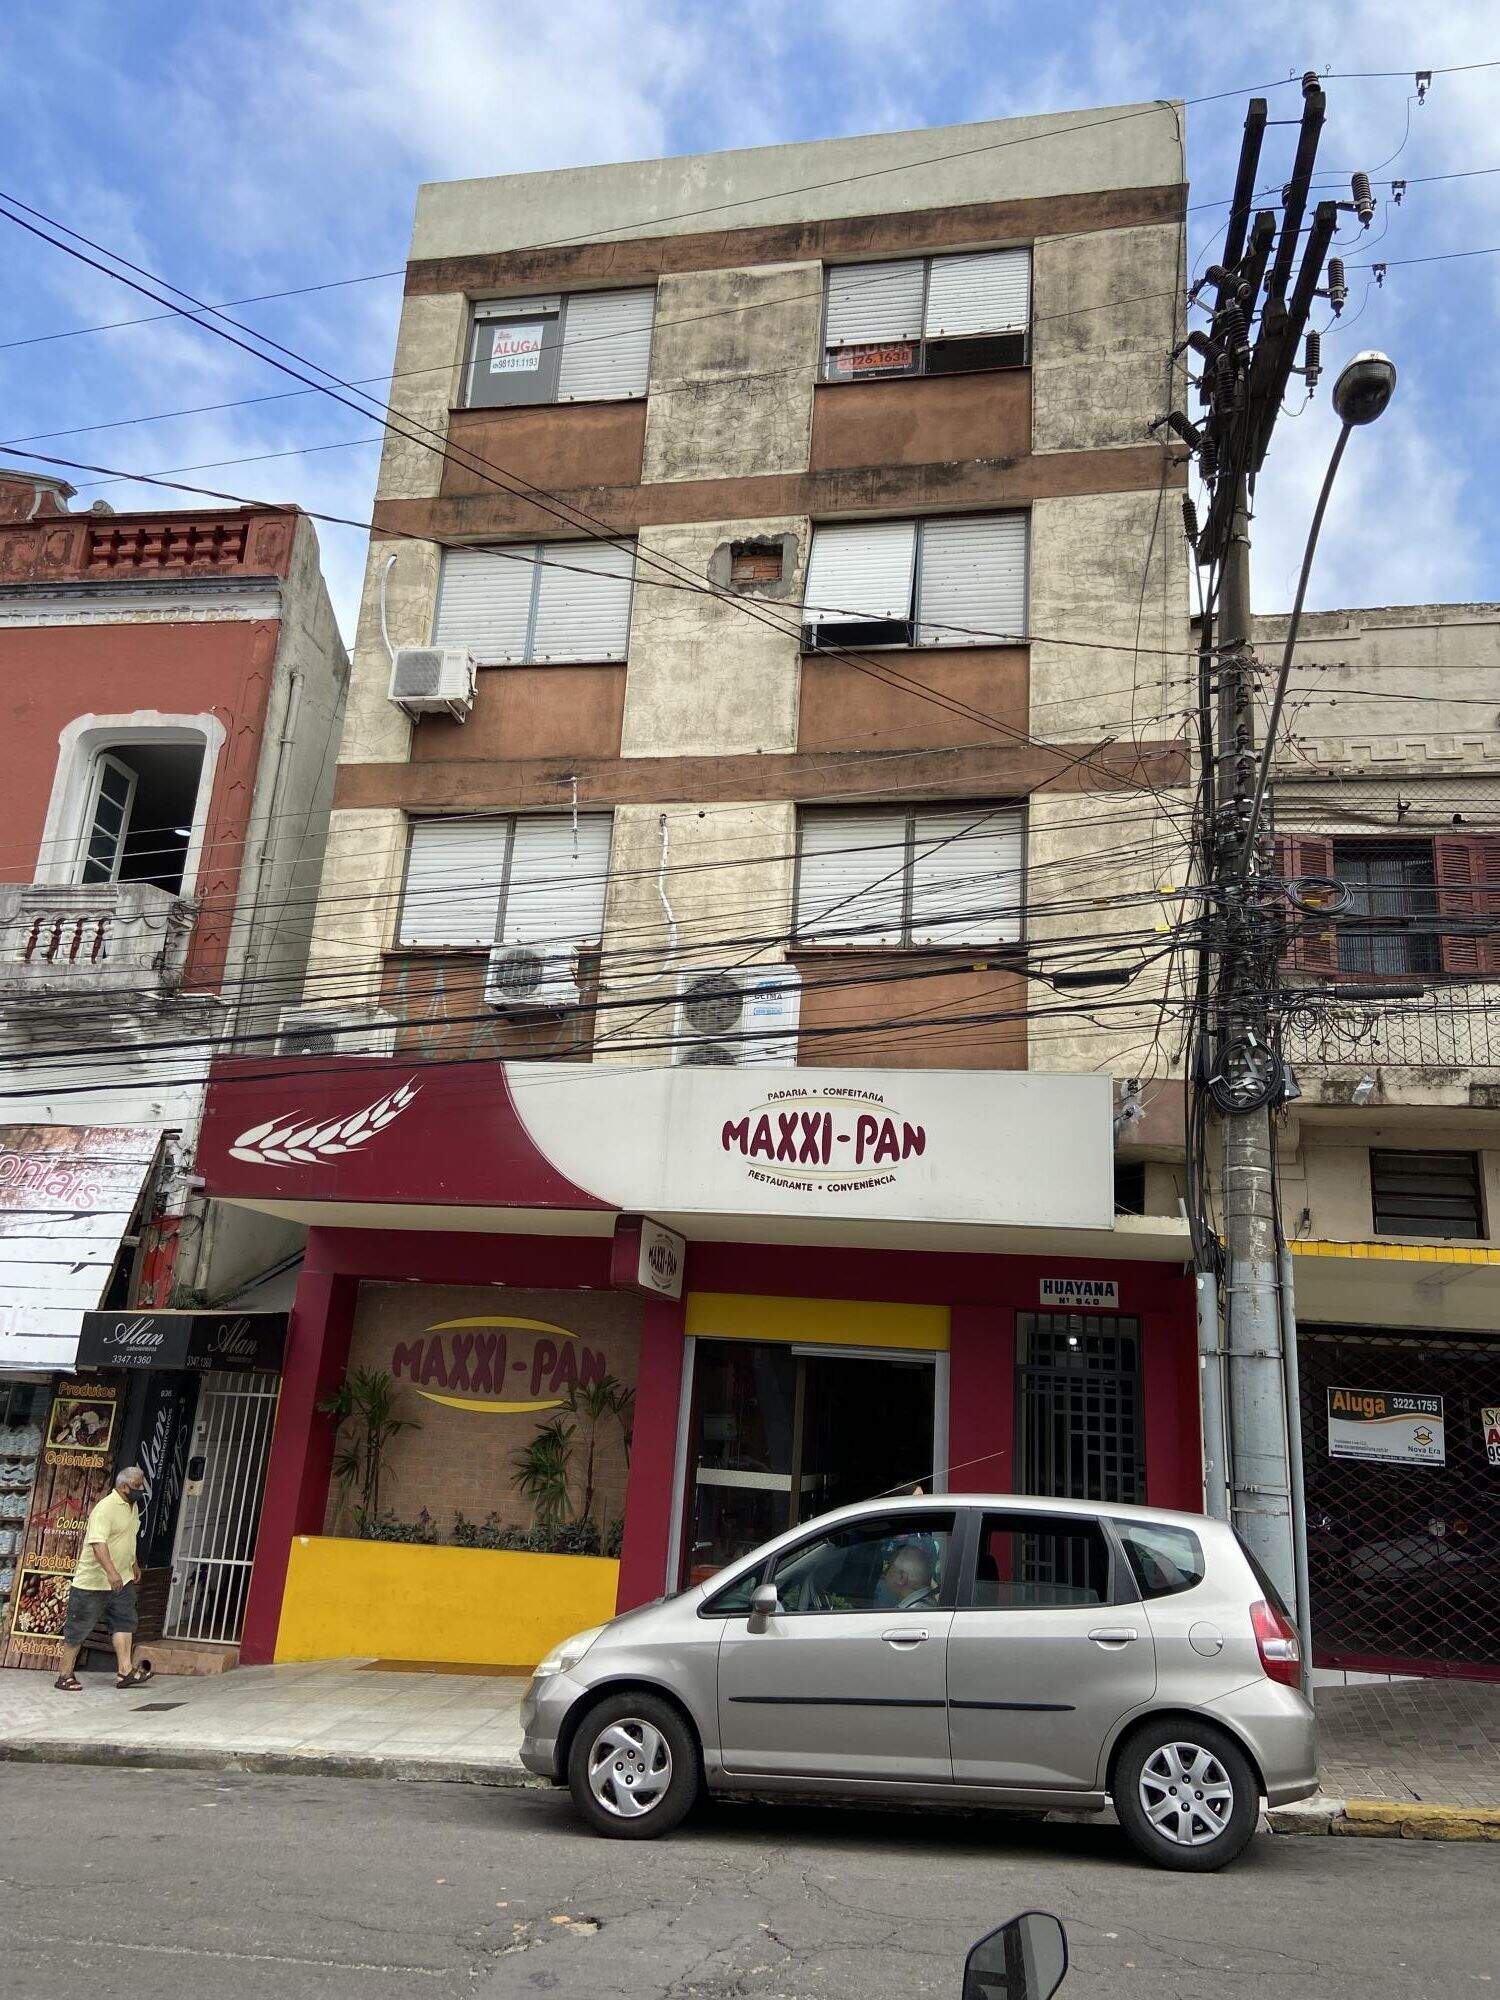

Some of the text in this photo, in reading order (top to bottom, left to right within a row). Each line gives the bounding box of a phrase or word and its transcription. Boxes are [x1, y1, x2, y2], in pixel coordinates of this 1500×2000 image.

[494, 340, 540, 355] ALUGA
[767, 1087, 884, 1103] PADARIA CONFEITARIA
[721, 1112, 927, 1165] MAXXI-PAN
[748, 1169, 813, 1192] RESTAURANTE
[1043, 1280, 1115, 1296] HUAYANA
[103, 1316, 164, 1346] Alan
[207, 1318, 257, 1355] Alan
[112, 1355, 152, 1364] 3347.1360
[392, 1333, 606, 1396] MAXXI-PAN
[58, 1382, 117, 1398] Produtos
[1332, 1390, 1438, 1418] Aluga 3222.1755
[1484, 1409, 1500, 1426] S
[1408, 1445, 1441, 1454] Nova Era
[45, 1451, 105, 1468] Coloniais
[26, 1552, 78, 1570] Produto
